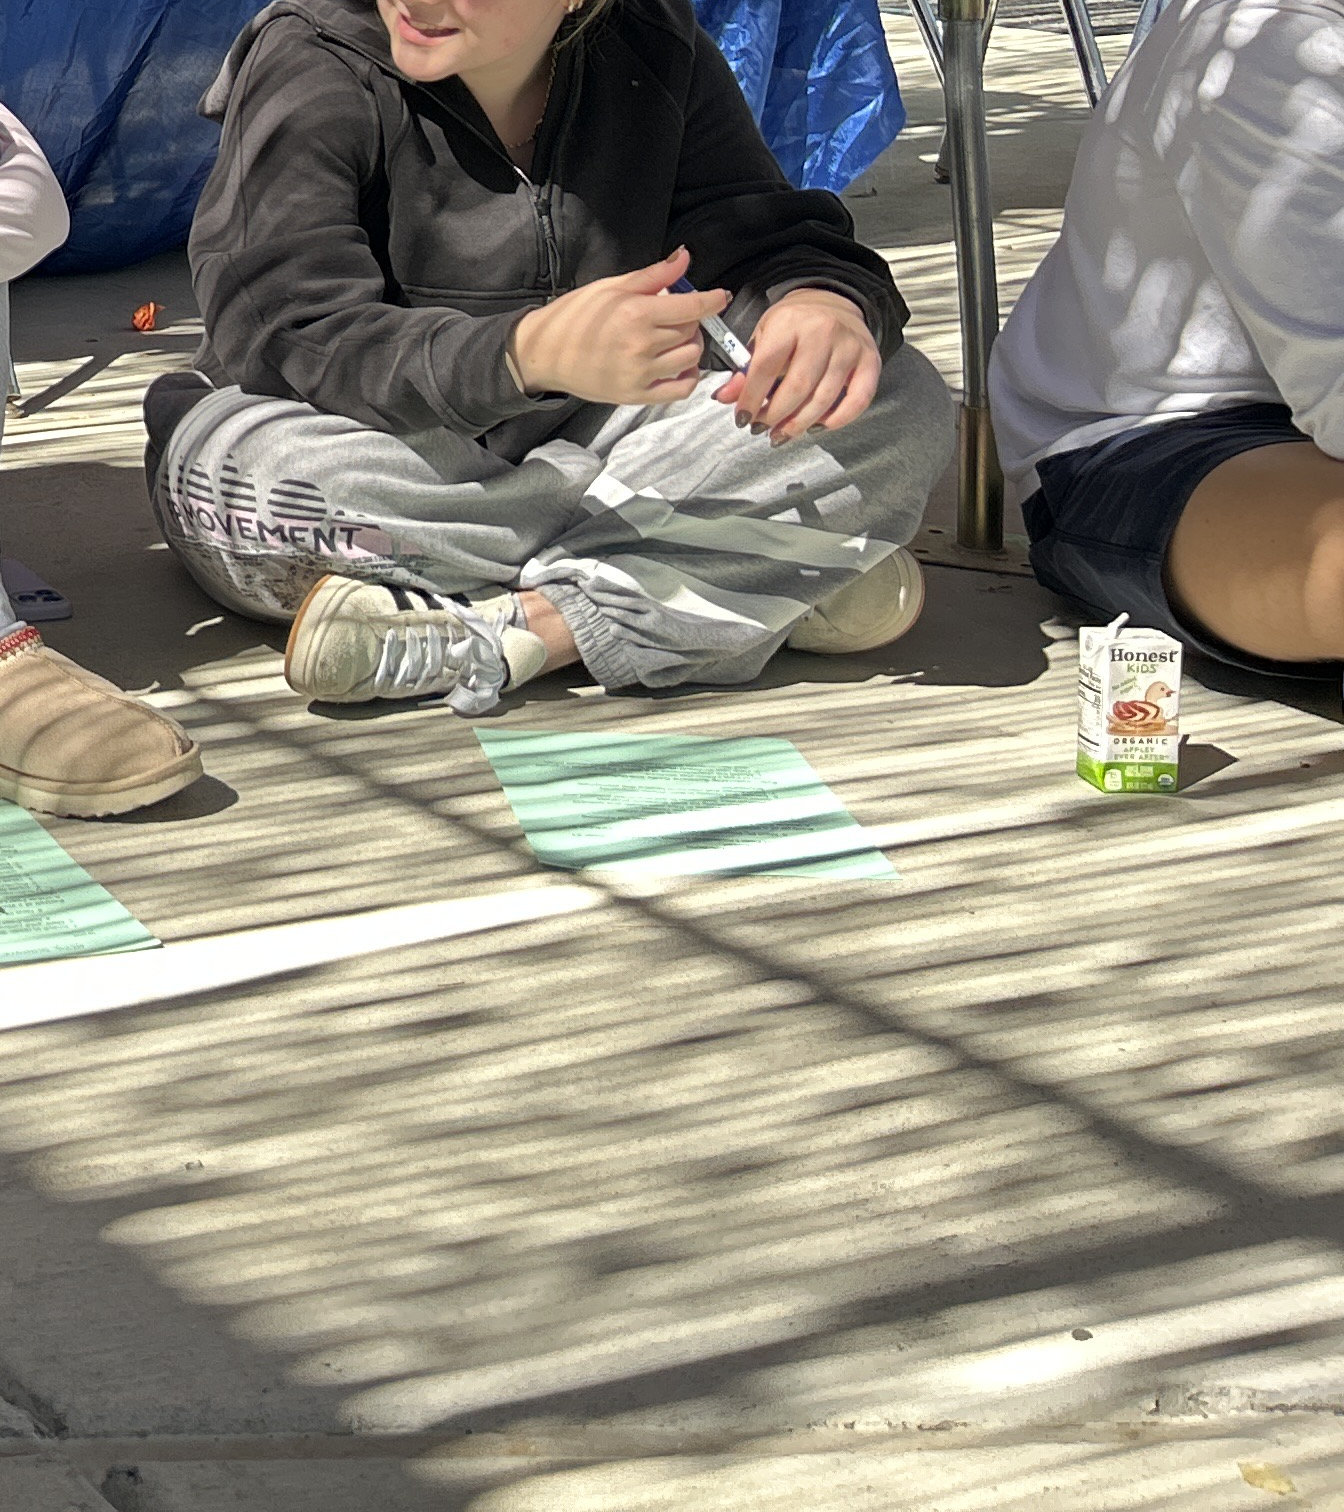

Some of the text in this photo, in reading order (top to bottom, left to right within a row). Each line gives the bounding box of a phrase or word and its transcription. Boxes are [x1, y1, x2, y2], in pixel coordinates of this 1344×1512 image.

[182, 501, 363, 553] MOVEMENT
[1110, 648, 1179, 663] Honest
[1113, 737, 1168, 745] ORGANIC
